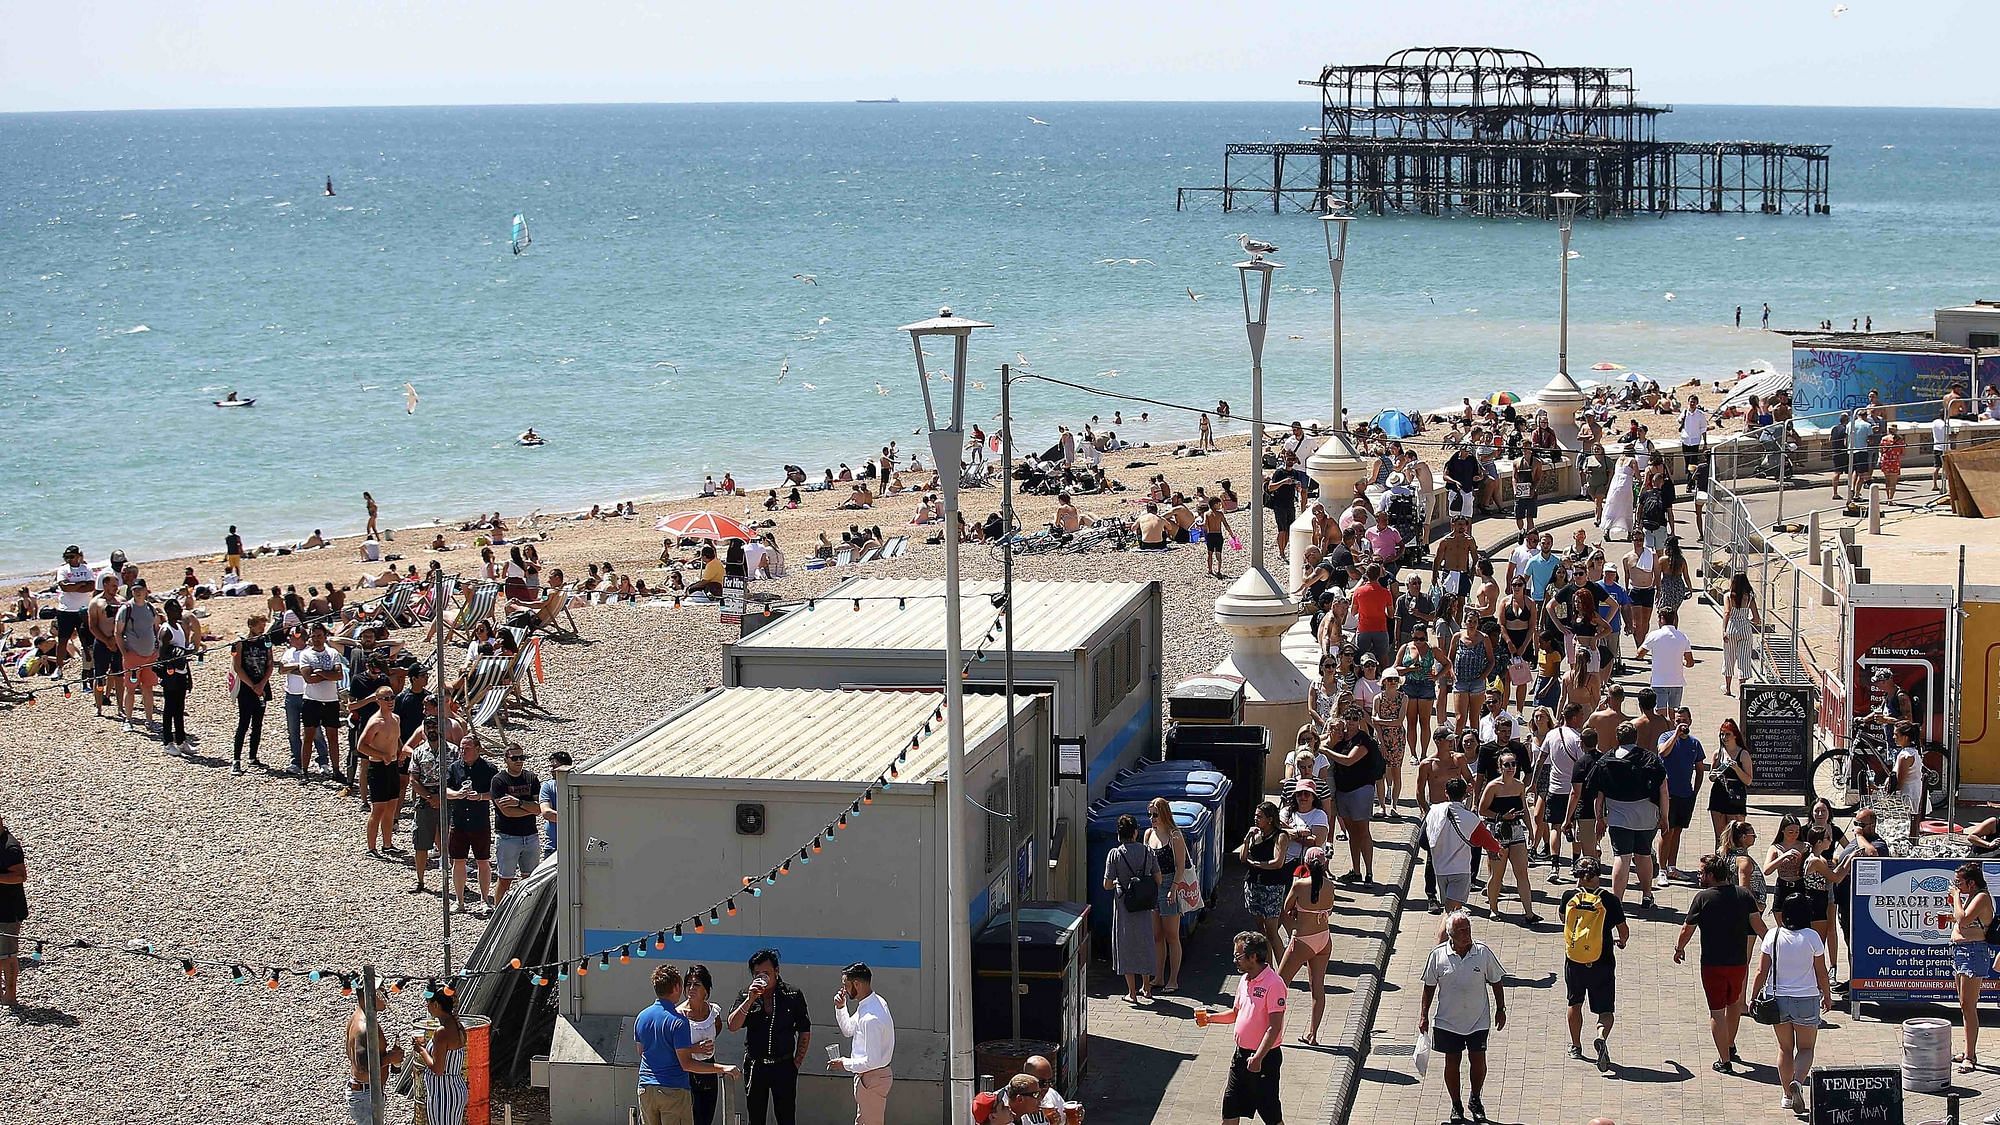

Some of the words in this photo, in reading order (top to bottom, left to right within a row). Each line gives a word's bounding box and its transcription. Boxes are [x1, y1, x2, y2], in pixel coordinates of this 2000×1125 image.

[724, 577, 732, 587] For
[733, 577, 744, 588] Hire
[1871, 647, 1890, 655] This
[1875, 895, 1930, 908] BEACH
[1887, 909, 1921, 930] FISH
[1924, 910, 1938, 926] &
[1867, 946, 1885, 956] Our
[1886, 946, 1910, 958] chips
[1910, 957, 1924, 966] the
[1926, 958, 1956, 968] premis
[1878, 967, 1890, 976] All
[1908, 968, 1925, 976] cod
[1926, 968, 1934, 976] is
[1934, 968, 1950, 976] line
[1822, 1076, 1893, 1091] TEMPEST
[1849, 1090, 1867, 1100] INN
[1826, 1108, 1855, 1124] TAKE
[1860, 1104, 1888, 1120] AWAY
